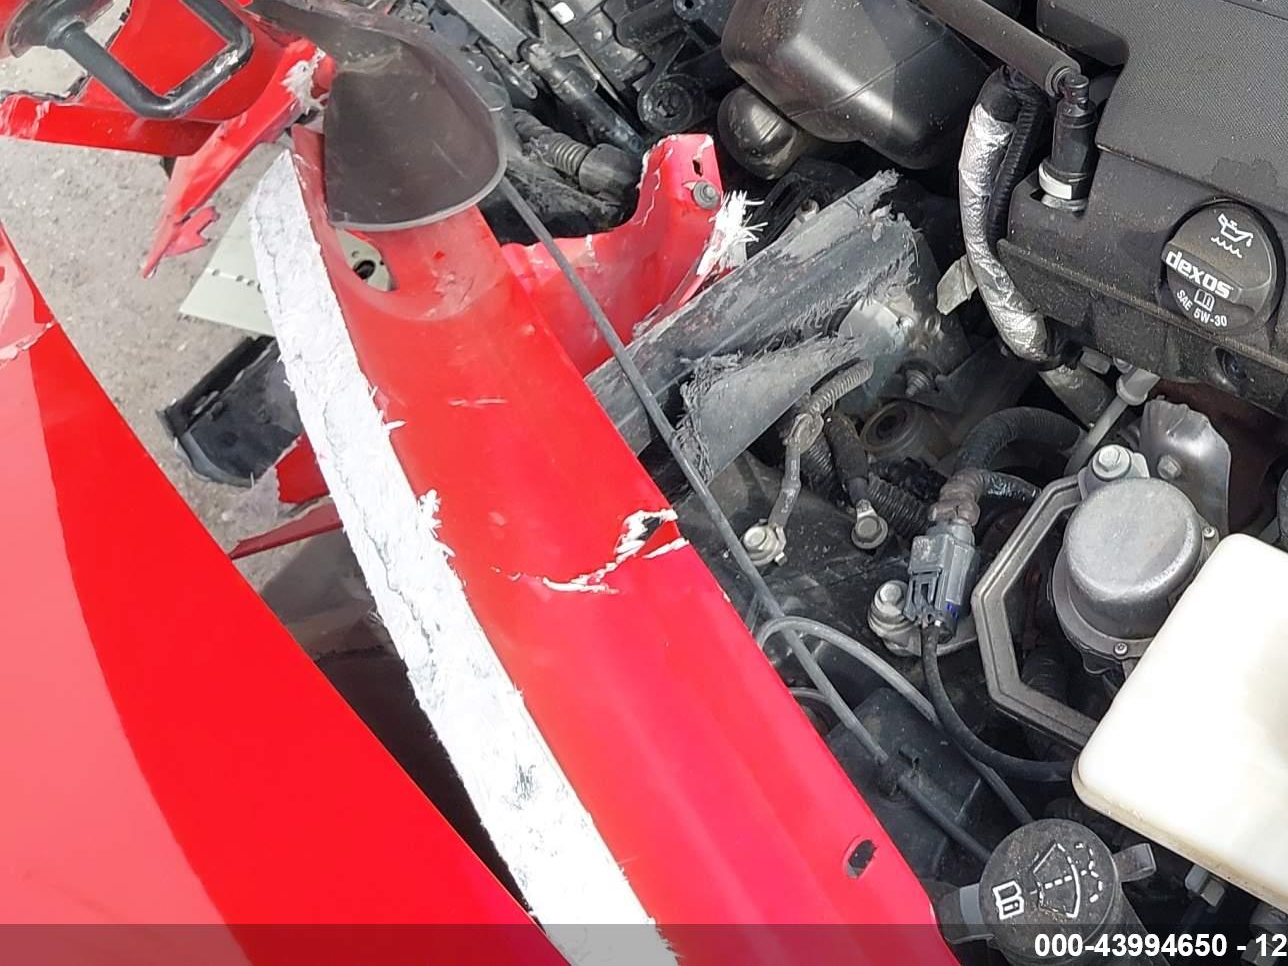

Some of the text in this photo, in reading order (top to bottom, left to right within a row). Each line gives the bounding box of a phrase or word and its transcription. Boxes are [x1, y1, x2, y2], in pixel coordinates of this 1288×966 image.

[1165, 250, 1233, 299] dexos
[1176, 289, 1228, 327] SAE 5W-30
